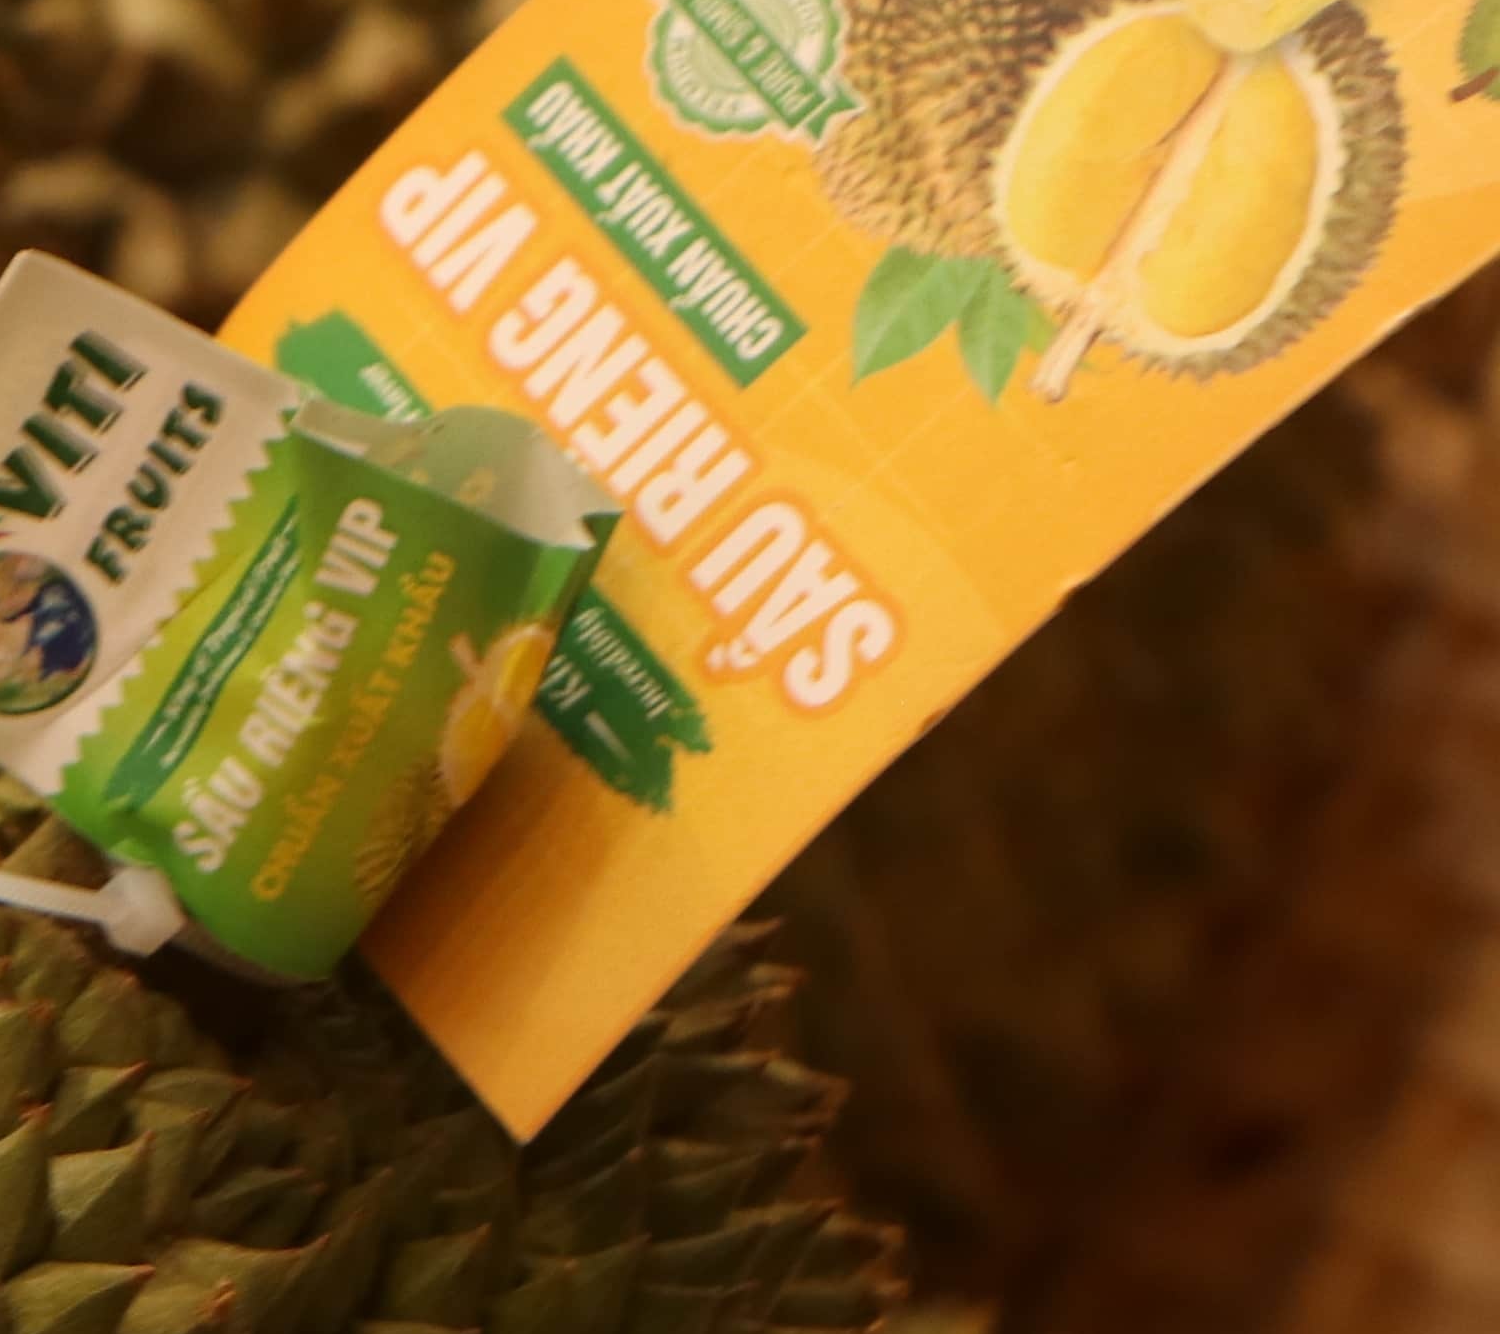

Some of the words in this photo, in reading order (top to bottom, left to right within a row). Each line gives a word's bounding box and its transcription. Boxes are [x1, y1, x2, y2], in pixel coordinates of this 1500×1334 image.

[377, 150, 539, 316] VIP
[596, 161, 693, 259] XUẤT
[85, 381, 225, 586] FRUITS
[313, 497, 399, 596] VIP
[573, 607, 673, 722] Incredibly
